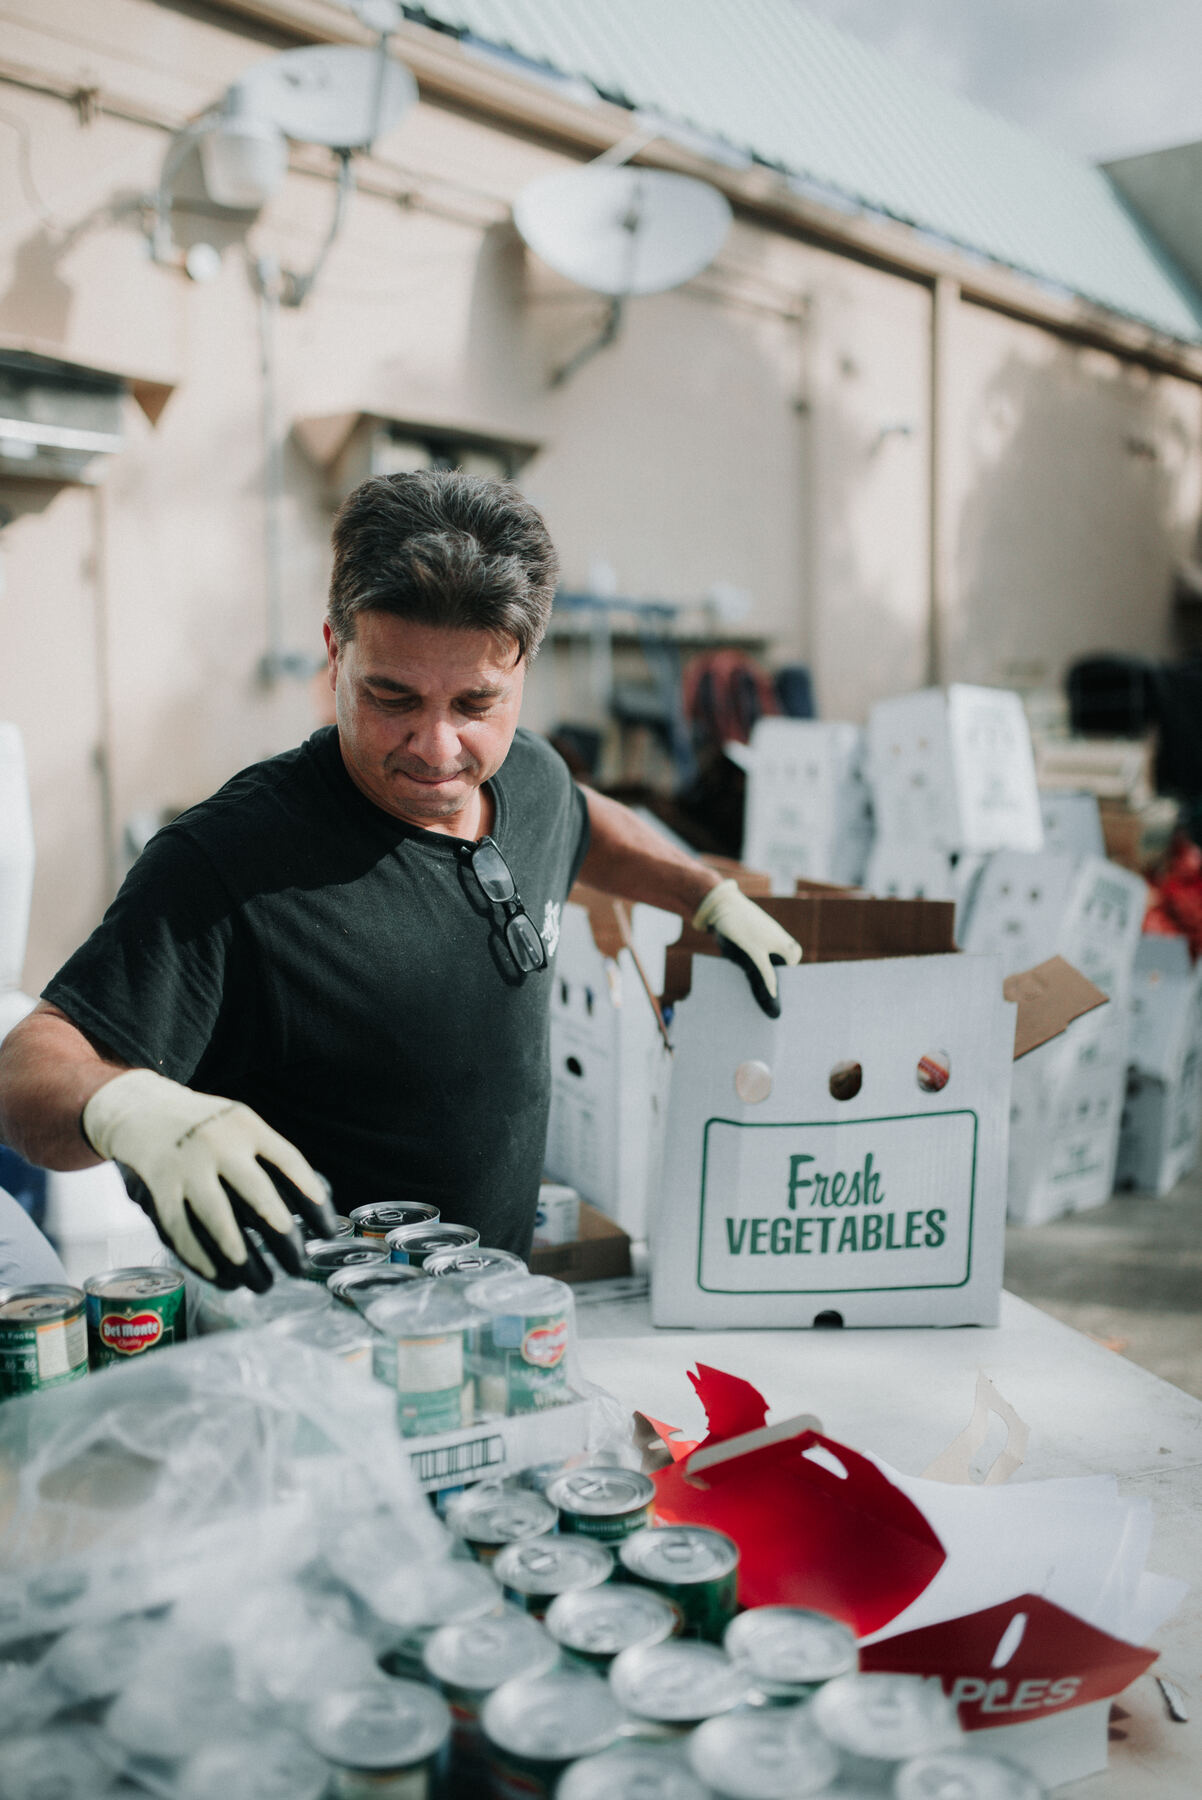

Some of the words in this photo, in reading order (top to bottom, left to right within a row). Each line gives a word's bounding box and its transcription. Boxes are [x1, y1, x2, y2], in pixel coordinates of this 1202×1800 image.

[787, 1152, 885, 1210] Fresh
[725, 1208, 946, 1255] VEGETABLES
[103, 1323, 120, 1337] Del
[121, 1321, 158, 1337] Monte
